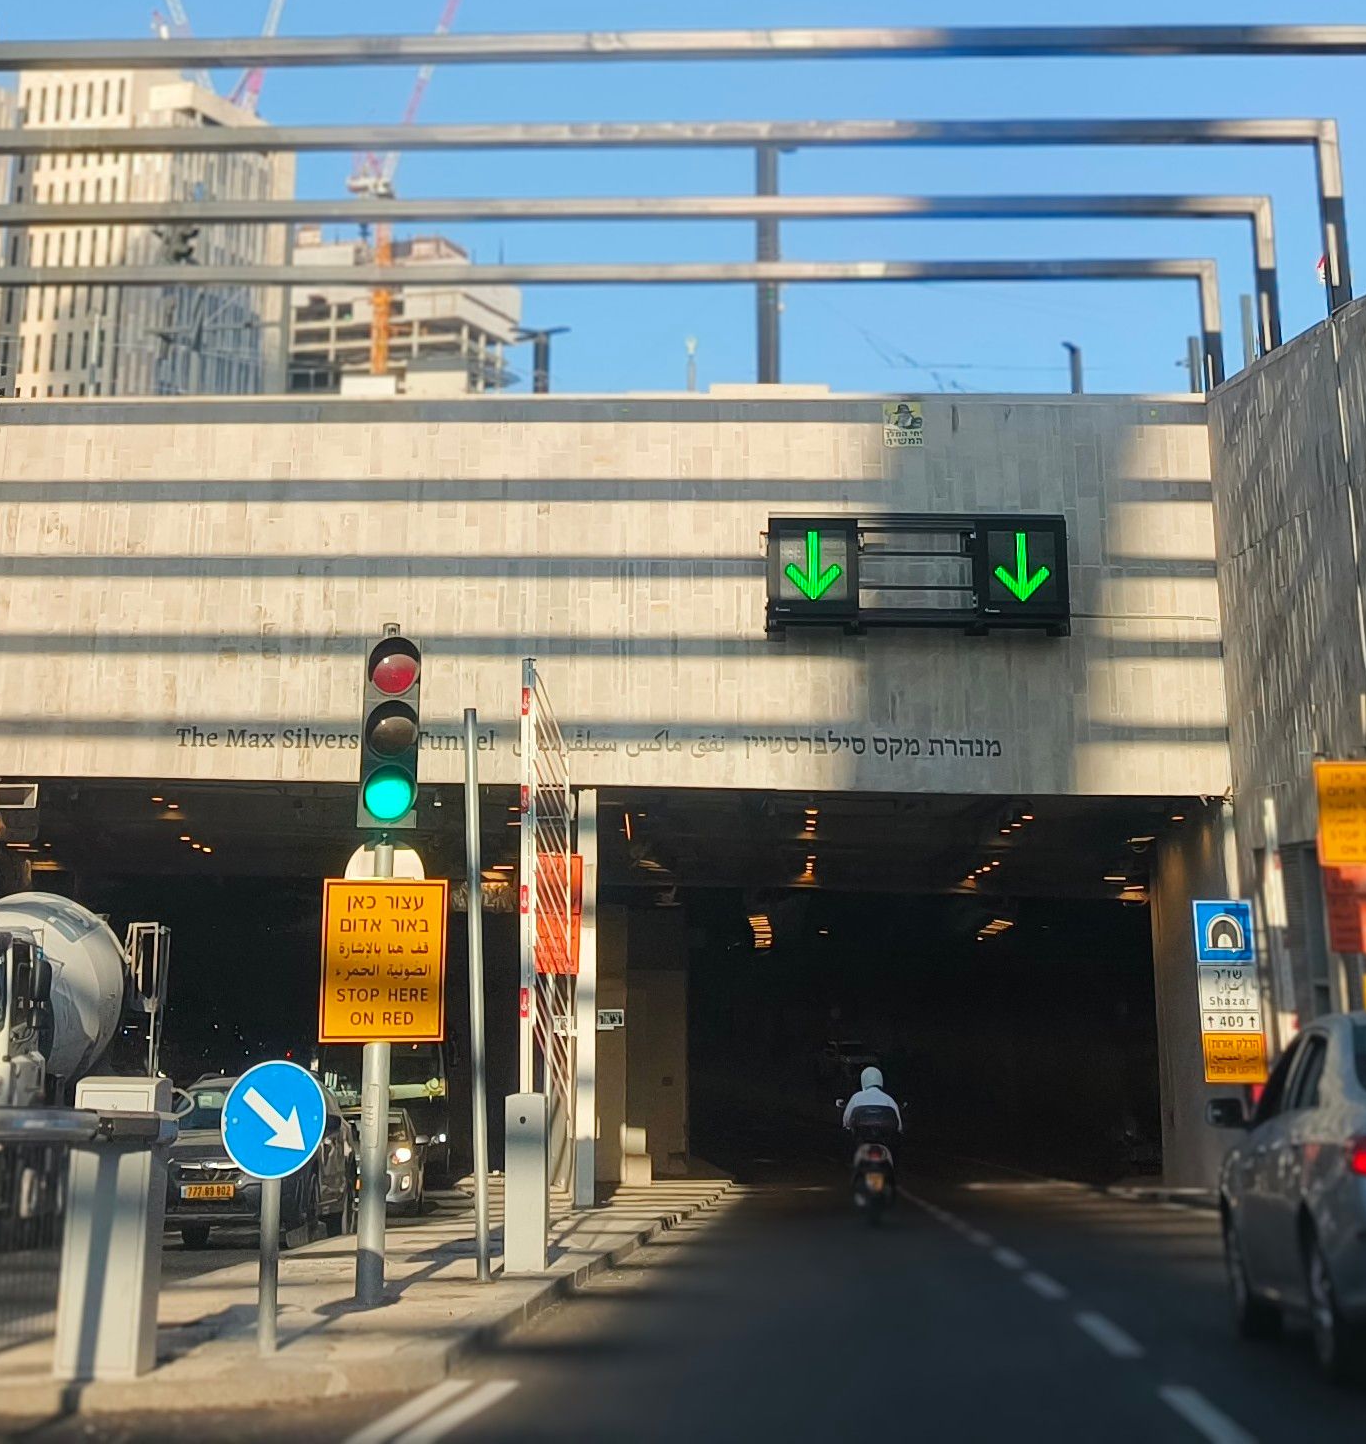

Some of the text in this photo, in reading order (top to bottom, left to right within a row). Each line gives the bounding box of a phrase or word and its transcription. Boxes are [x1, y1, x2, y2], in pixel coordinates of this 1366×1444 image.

[176, 728, 218, 748] The
[225, 730, 275, 748] Max
[282, 728, 360, 750] Silvers
[874, 736, 921, 760] מקס
[929, 737, 1002, 757] מנהרת
[347, 896, 424, 913] עצור כאן
[340, 919, 429, 932] באור אדום
[337, 988, 429, 1002] STOP HERE
[1209, 996, 1251, 1006] Shazar
[350, 1012, 414, 1025] ON RED
